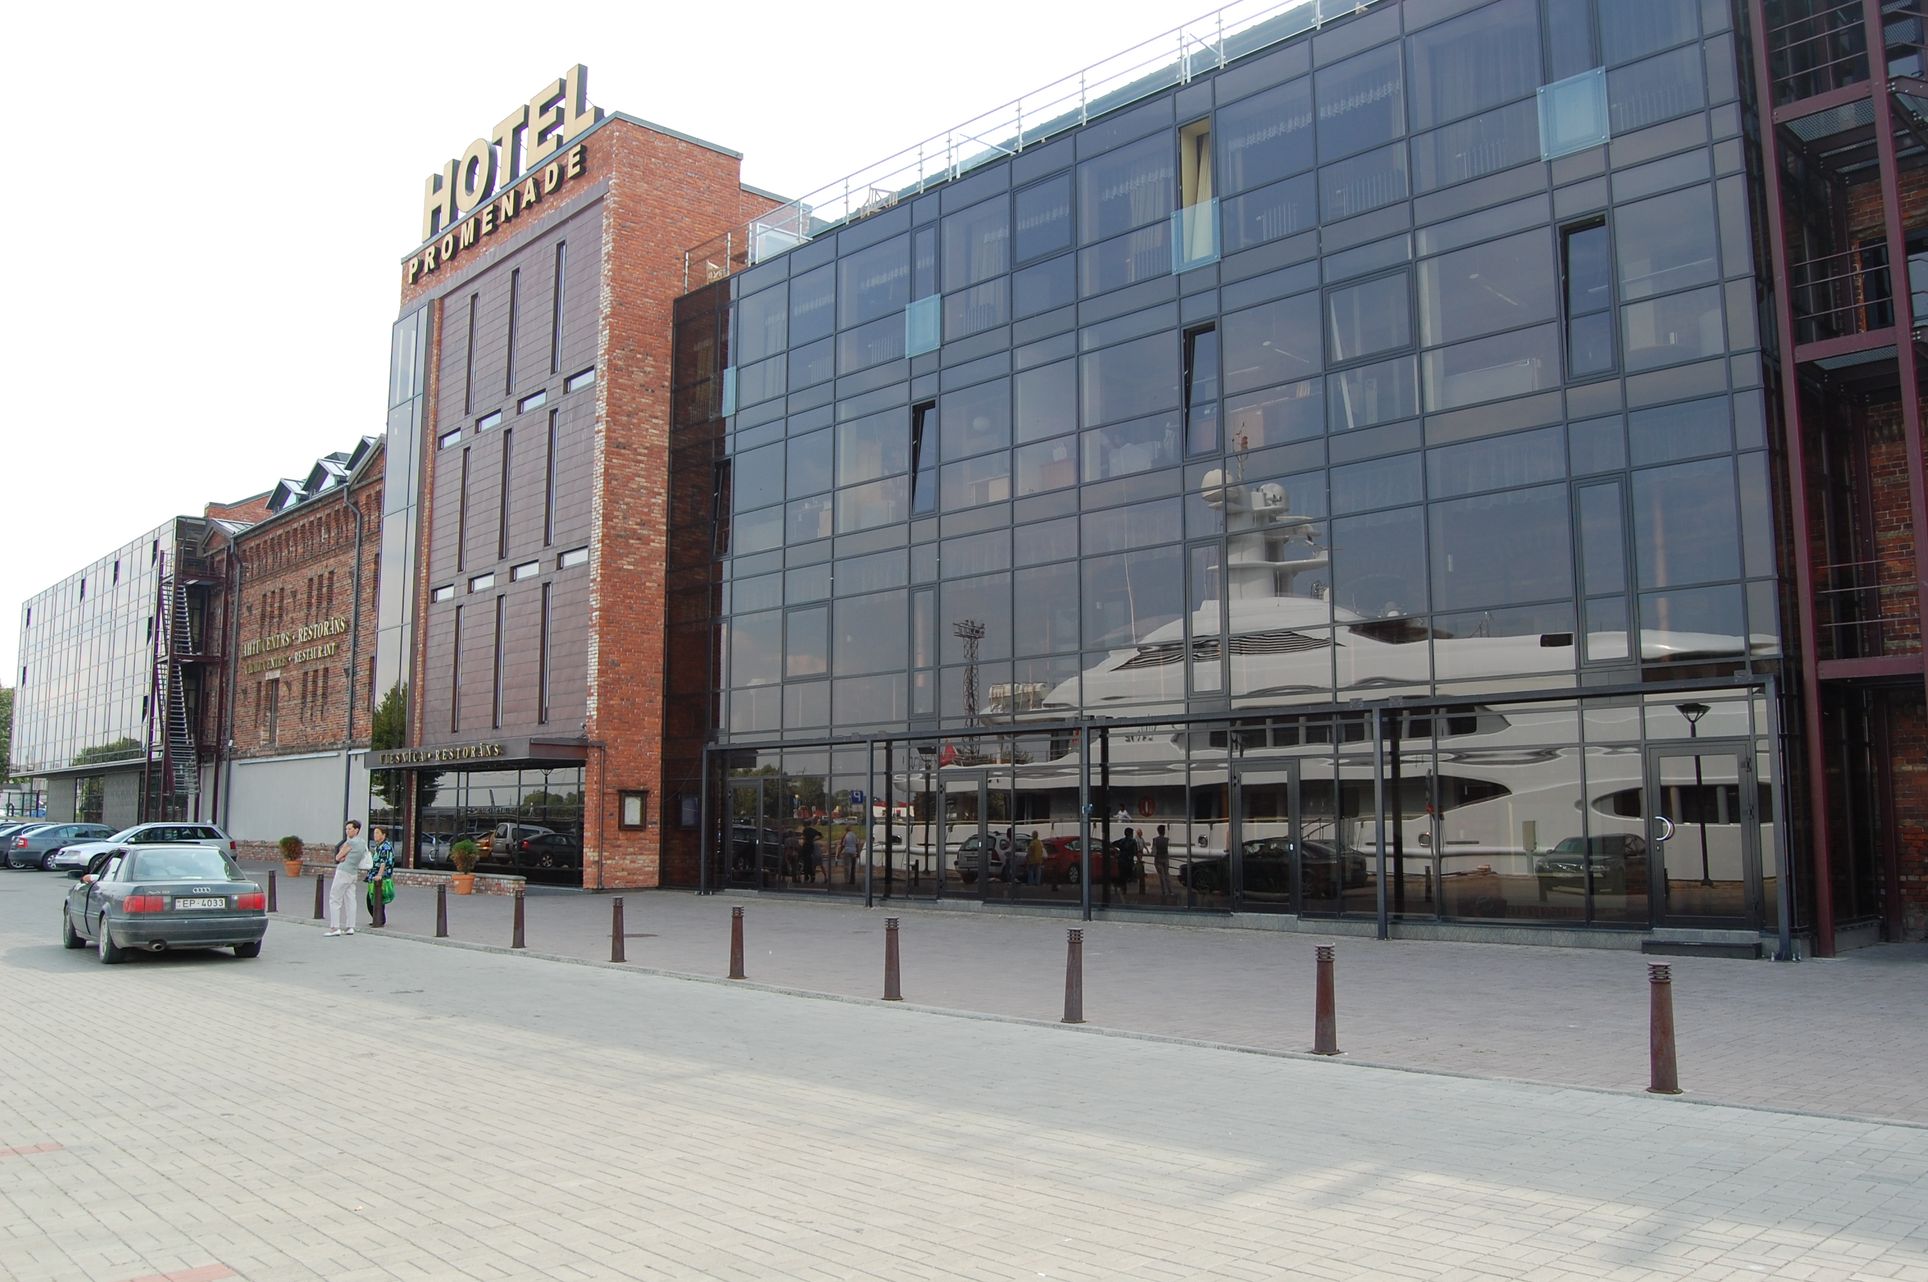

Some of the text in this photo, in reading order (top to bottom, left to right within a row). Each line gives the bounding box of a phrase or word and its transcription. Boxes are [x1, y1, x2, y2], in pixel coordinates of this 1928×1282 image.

[408, 144, 586, 284] PROMENADE
[421, 63, 602, 243] HOTEL
[294, 642, 336, 664] RESTAURANT
